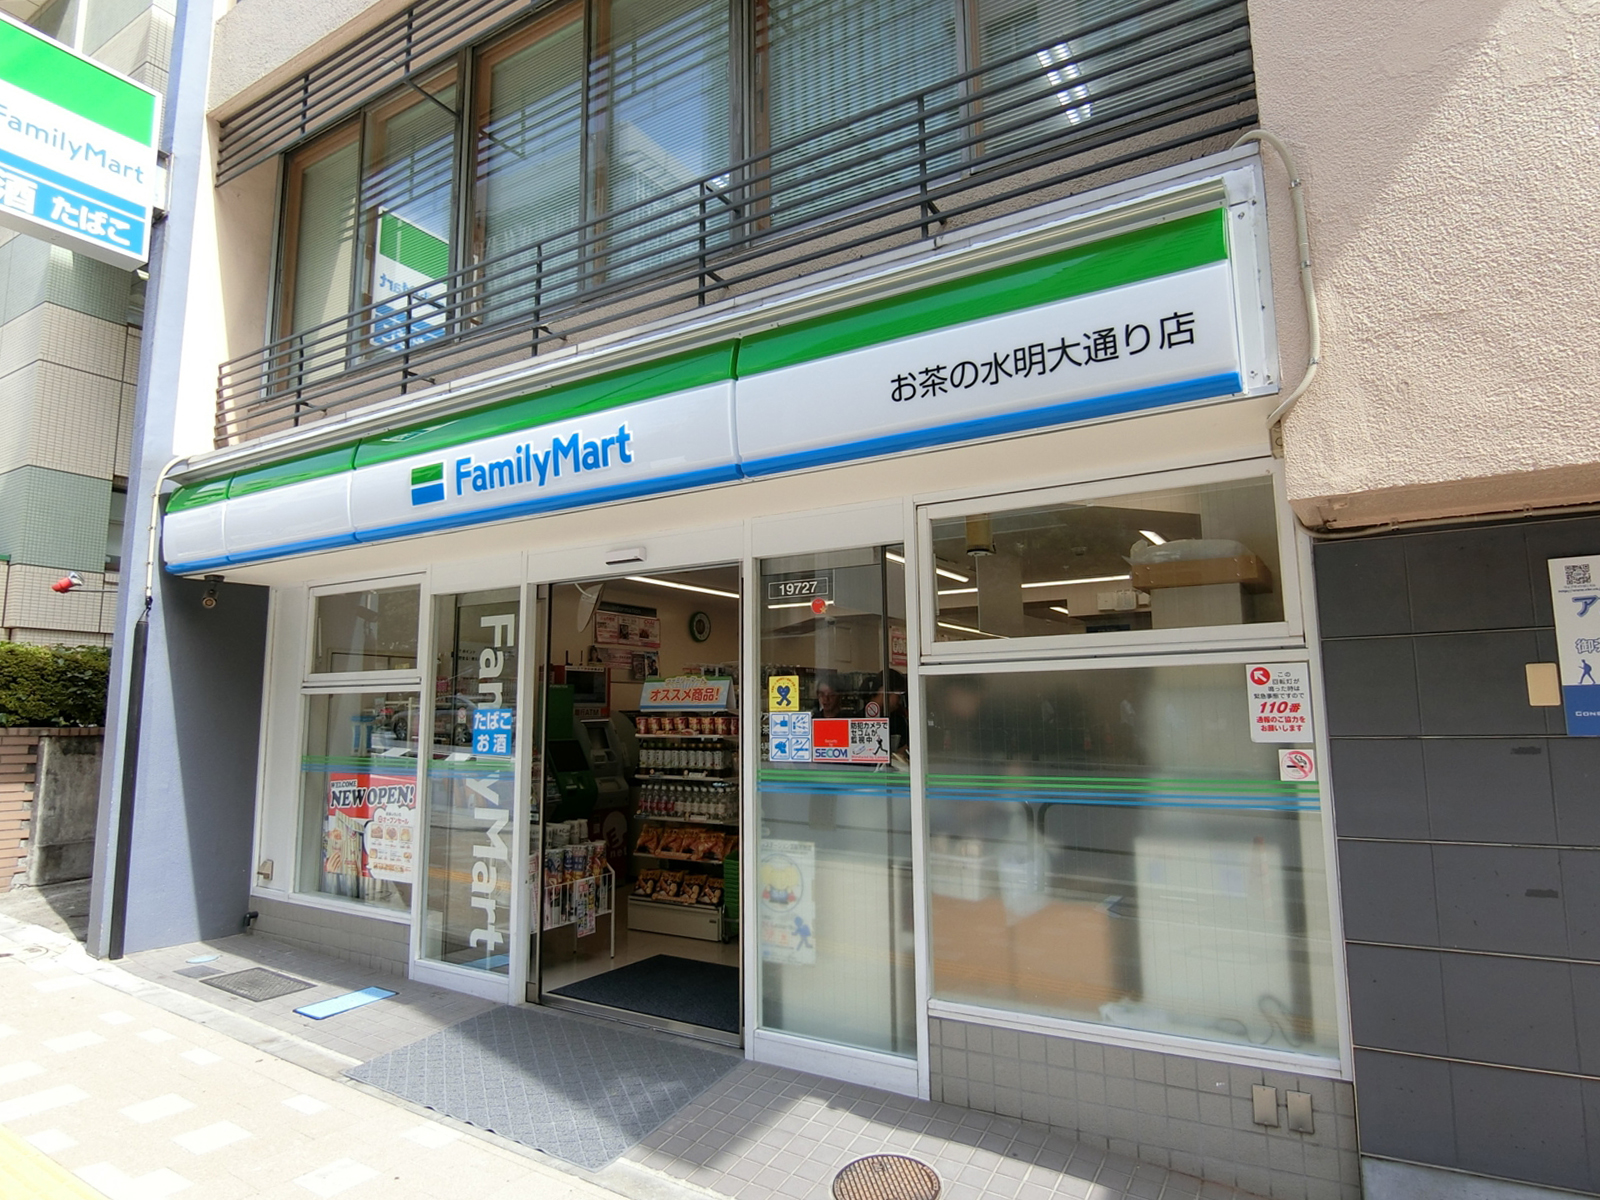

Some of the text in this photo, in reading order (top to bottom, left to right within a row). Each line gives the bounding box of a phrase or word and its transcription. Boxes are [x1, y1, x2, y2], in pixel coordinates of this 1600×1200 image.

[51, 196, 131, 246] たばこ
[889, 311, 1196, 403] お茶の水明大通り店
[456, 424, 633, 496] FamilyMart
[779, 581, 817, 596] 19727
[650, 687, 721, 702] オススメ商品!
[1259, 701, 1301, 714] 110番
[474, 711, 511, 730] たばこ
[851, 721, 888, 730] 防犯カメラで
[1256, 715, 1306, 724] 通報のご協力を
[851, 729, 877, 737] セコムが
[1260, 724, 1303, 732] お願いします
[477, 733, 507, 754] お酒
[851, 736, 873, 744] 監視中
[815, 748, 848, 758] SECOM
[331, 780, 356, 788] WELCOME
[331, 785, 414, 807] NEW OPEN!
